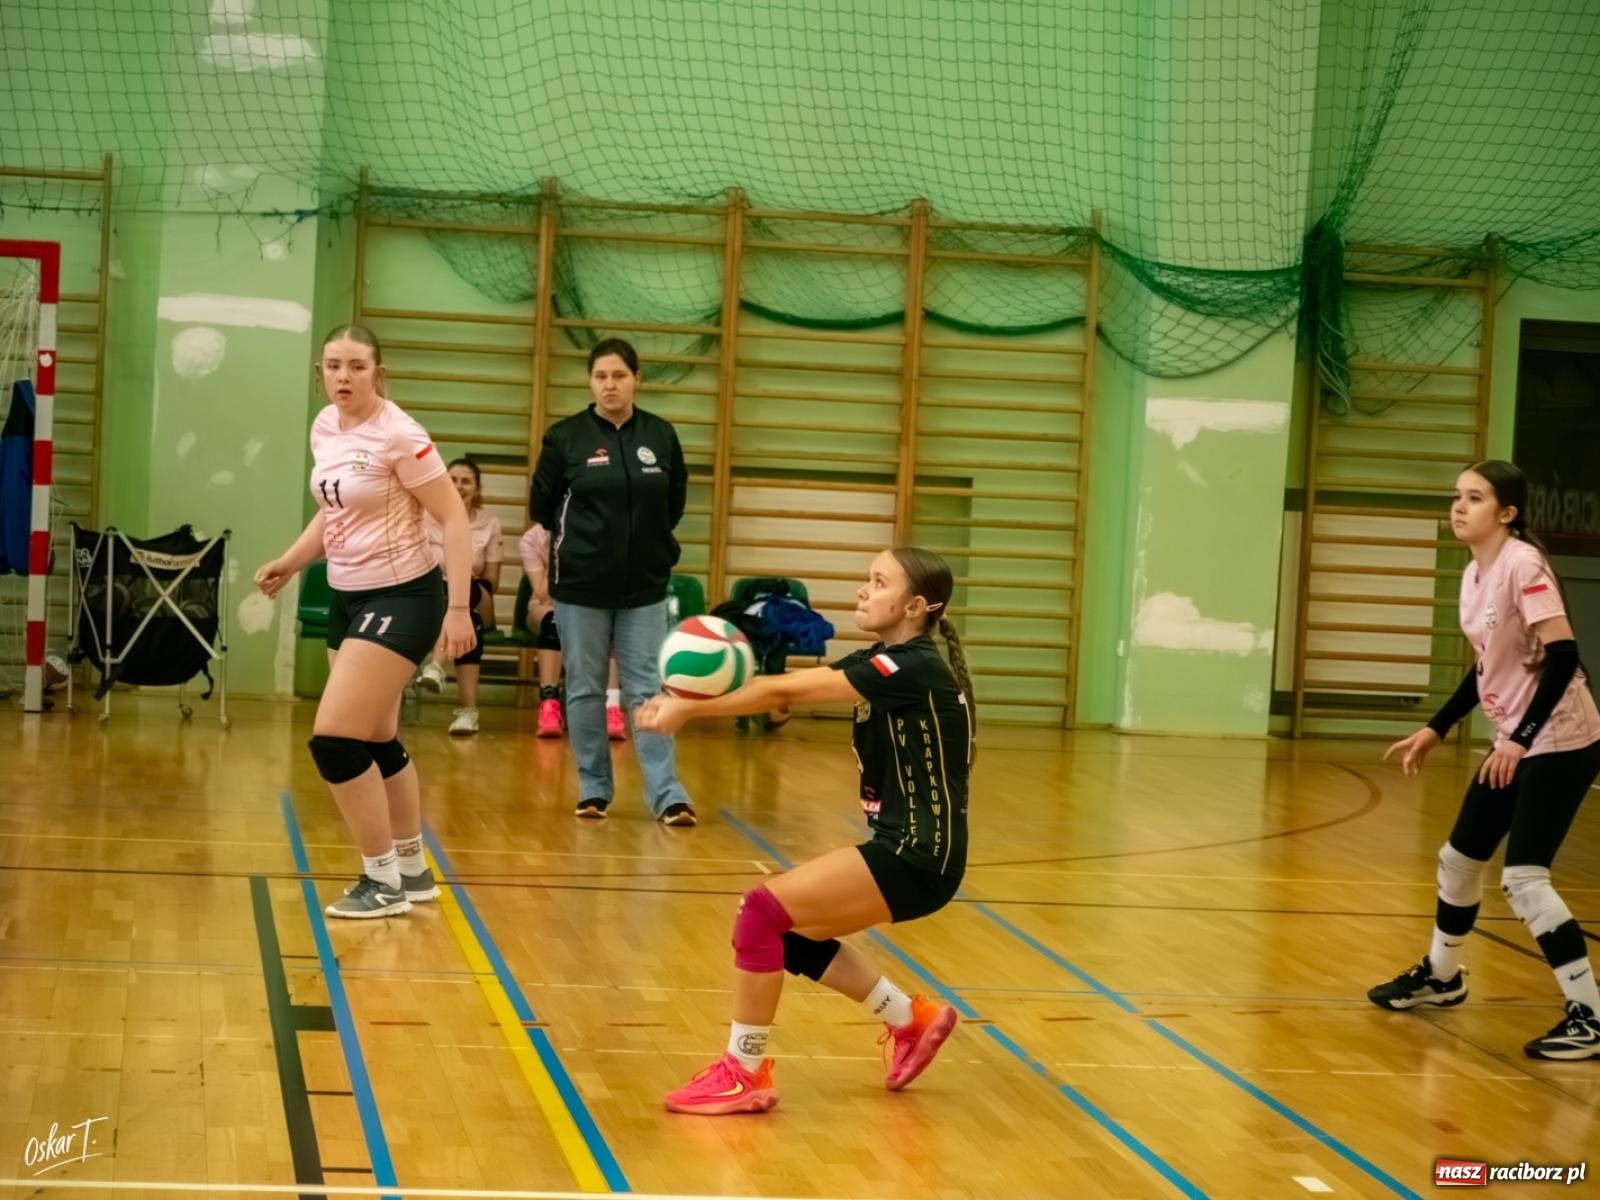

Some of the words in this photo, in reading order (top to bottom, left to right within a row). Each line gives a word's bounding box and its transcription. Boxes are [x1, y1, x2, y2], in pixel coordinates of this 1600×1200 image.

[319, 479, 344, 509] 11
[358, 612, 393, 636] 11
[919, 719, 942, 857] KRAPKOWICE
